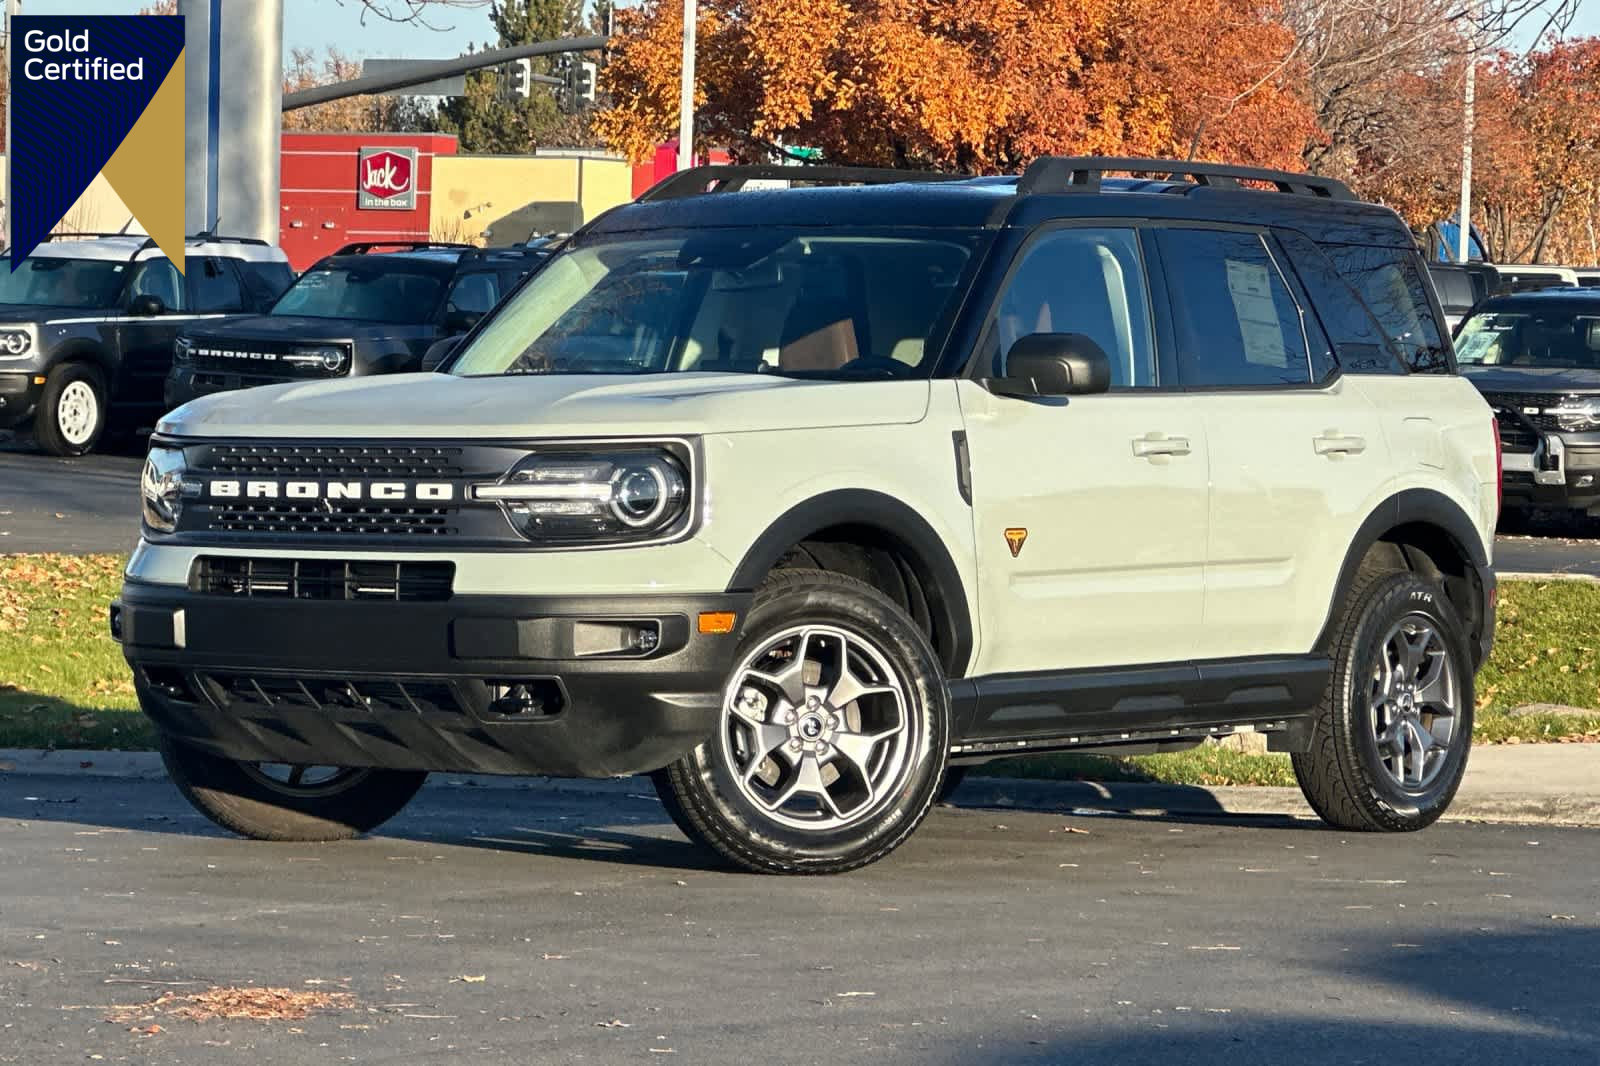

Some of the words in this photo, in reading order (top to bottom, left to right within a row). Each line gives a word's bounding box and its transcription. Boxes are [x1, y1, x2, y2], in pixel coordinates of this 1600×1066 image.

[363, 156, 409, 190] Jack
[365, 197, 373, 207] in
[374, 199, 390, 207] the
[391, 199, 407, 207] box
[198, 349, 277, 361] BRONCO
[209, 480, 454, 500] BRONCO
